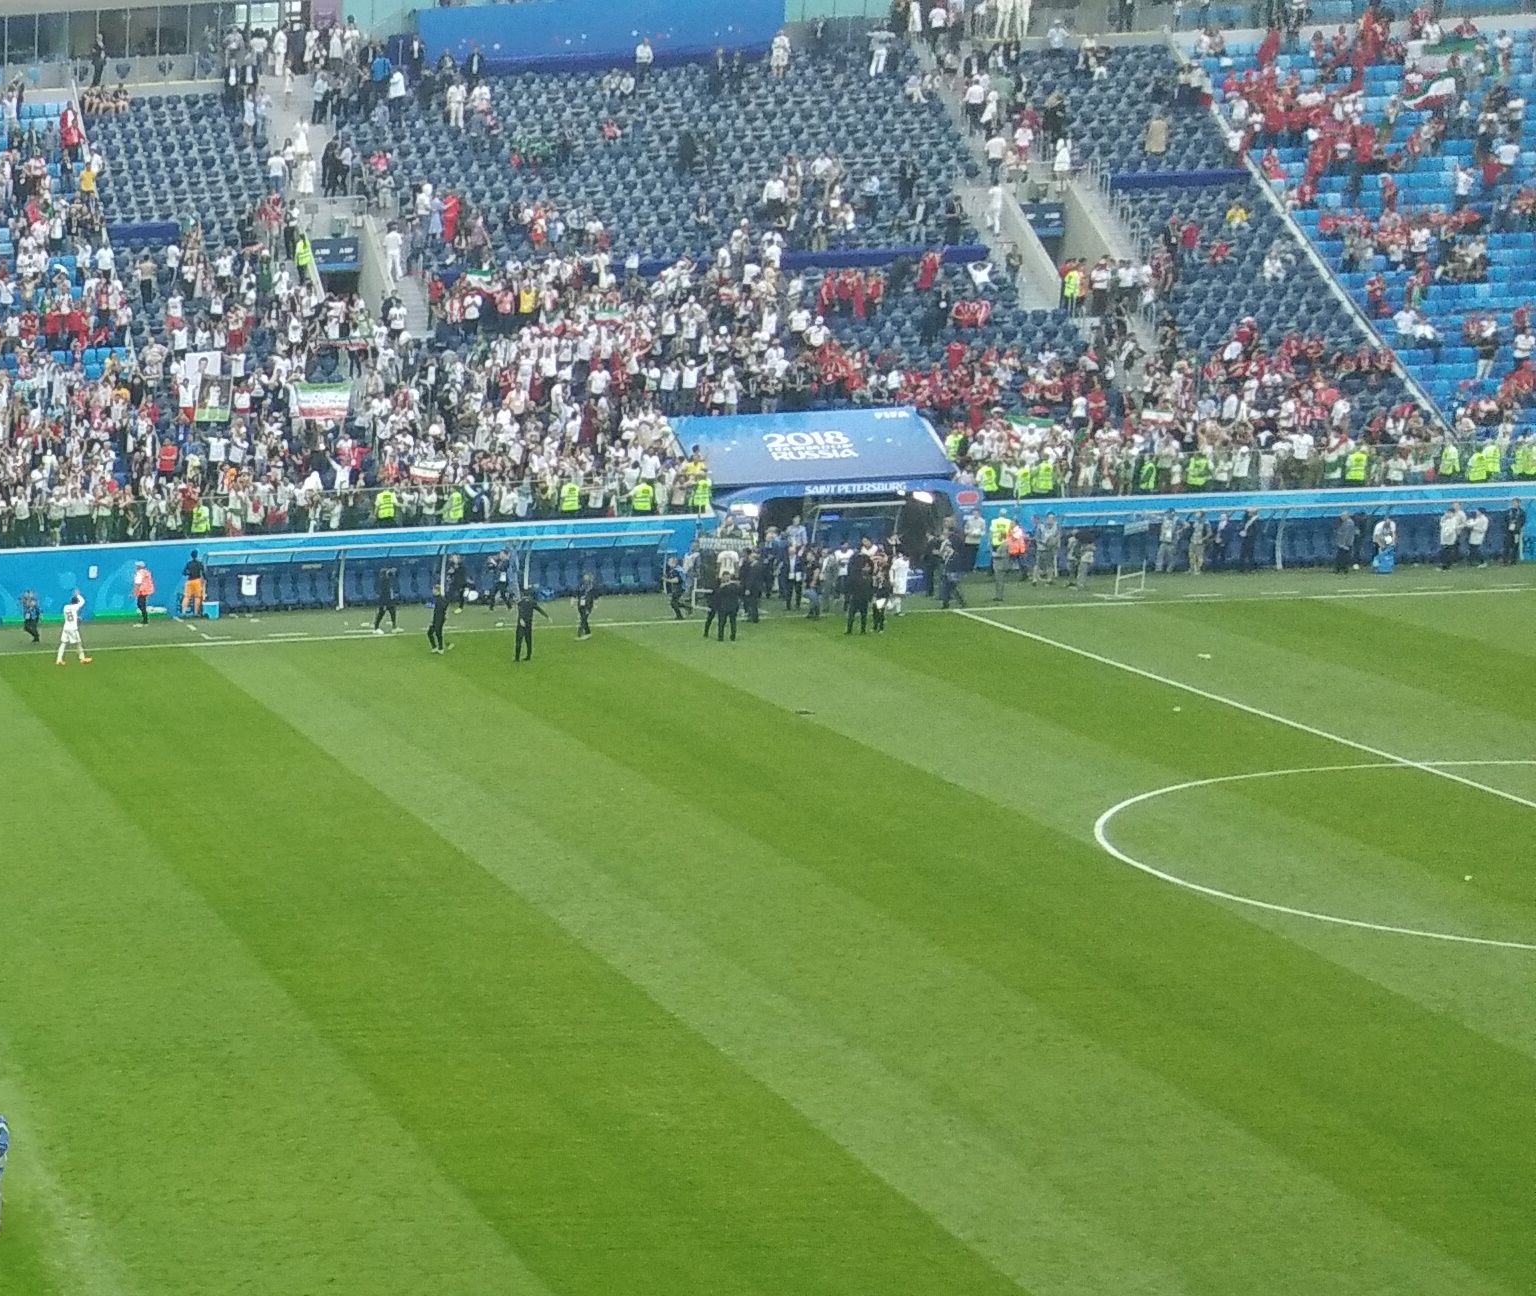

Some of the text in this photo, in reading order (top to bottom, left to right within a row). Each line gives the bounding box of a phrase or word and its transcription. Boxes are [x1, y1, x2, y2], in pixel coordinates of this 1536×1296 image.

[763, 431, 850, 447] 2018
[770, 449, 859, 461] RUSSIA
[804, 481, 908, 495] SAINT PETERSBURG
